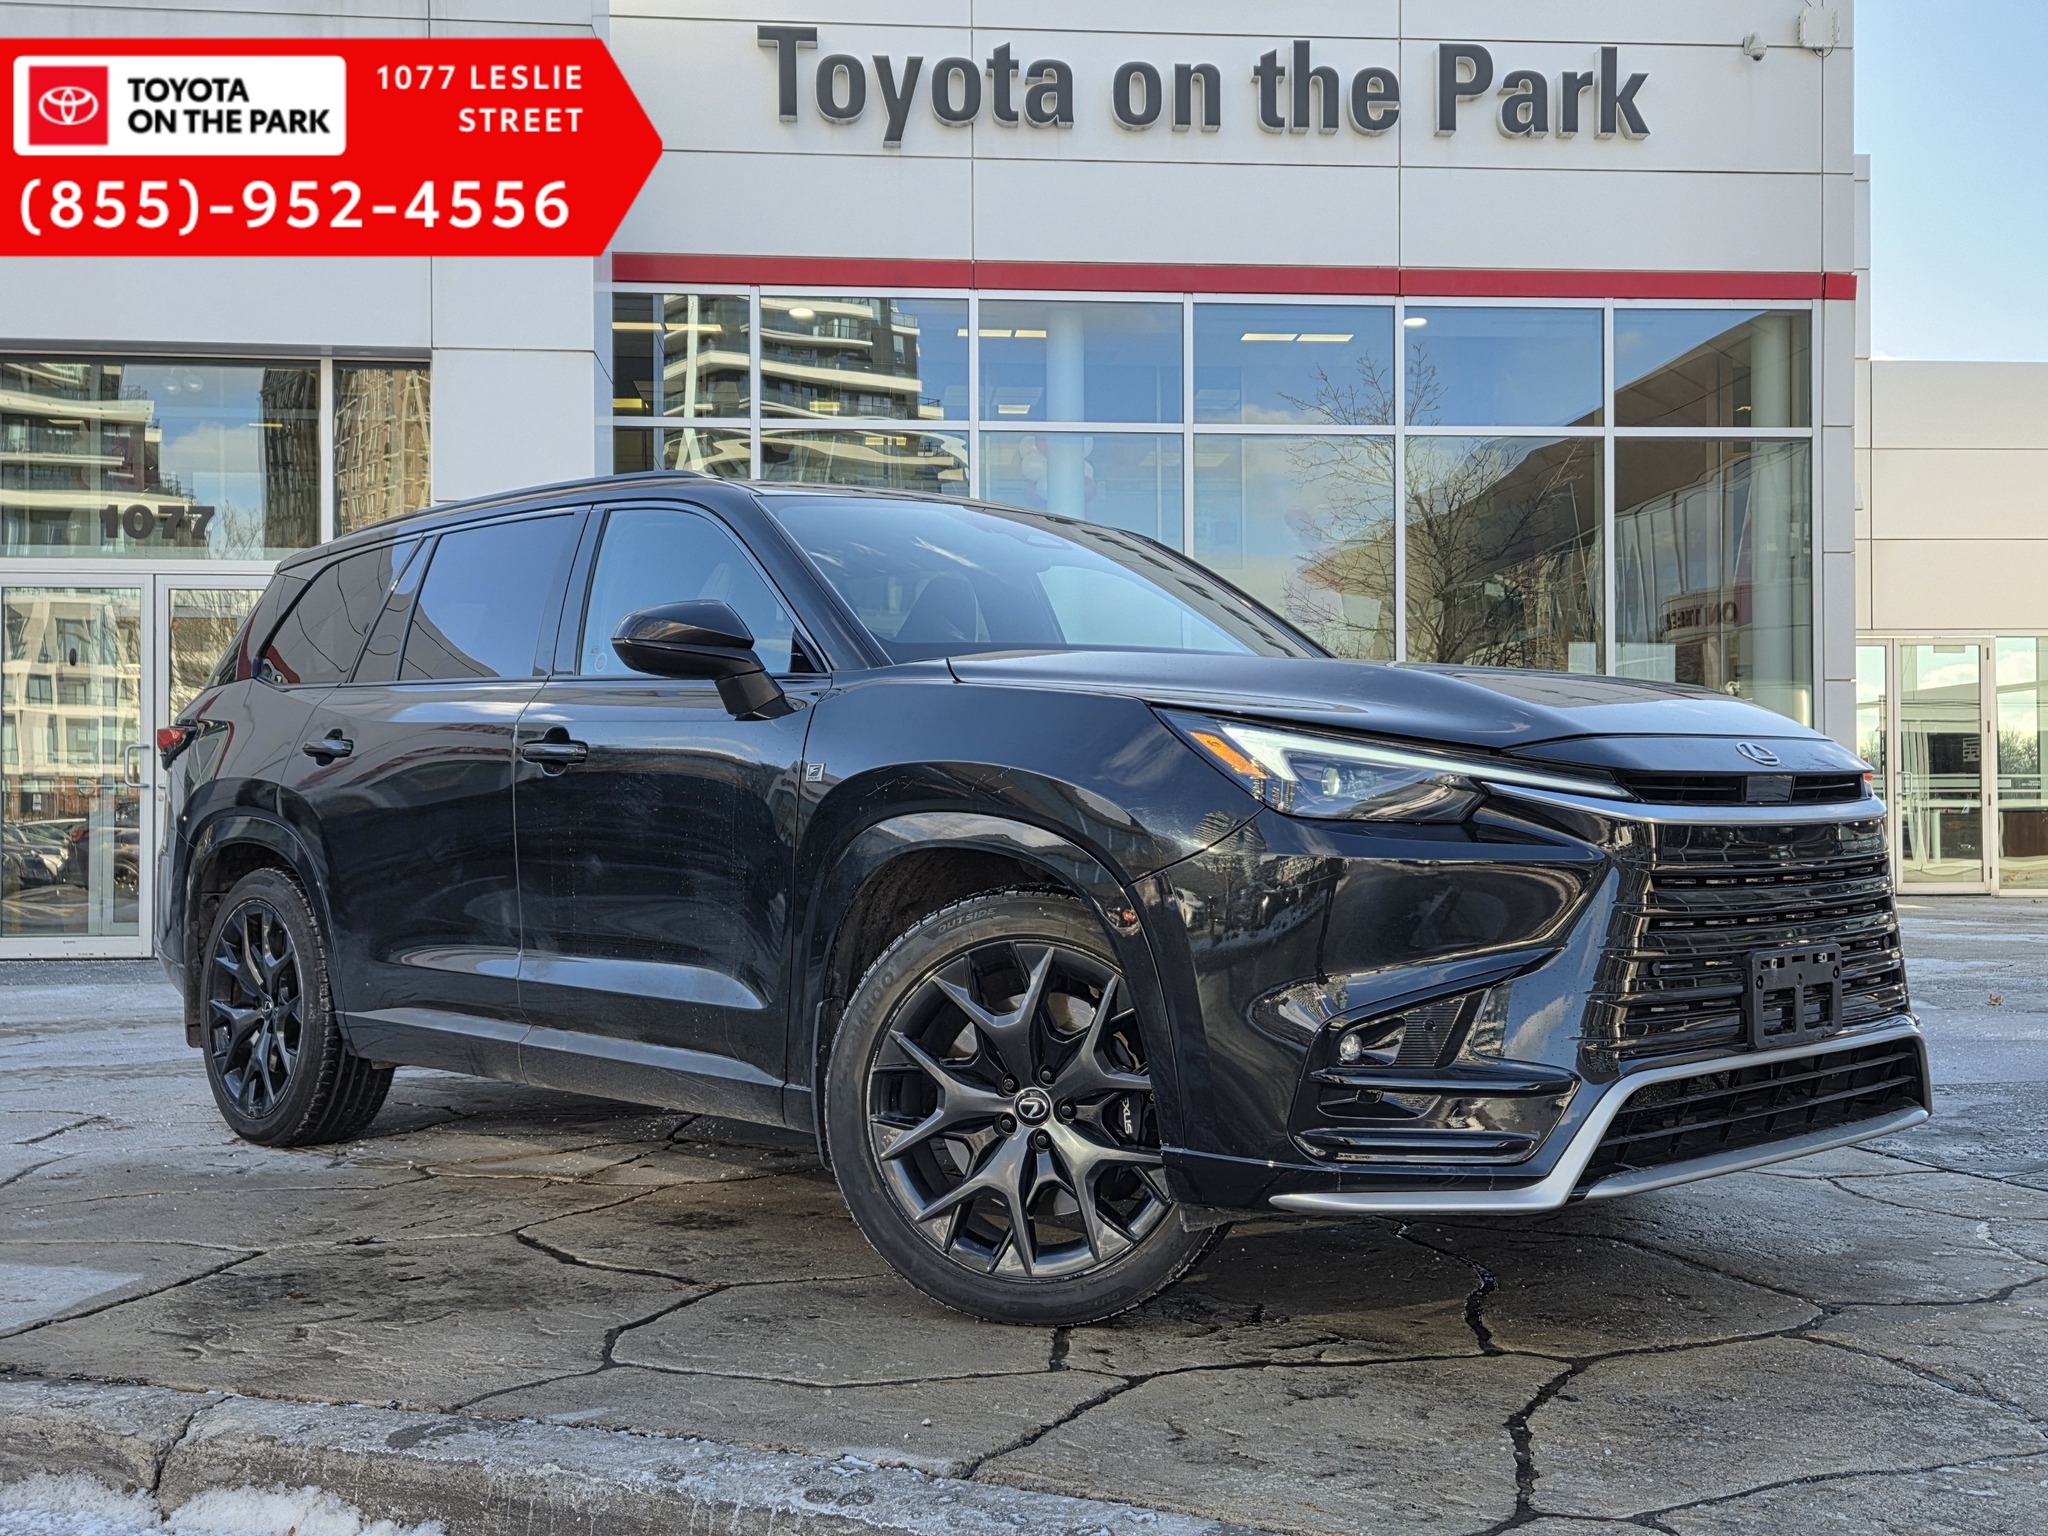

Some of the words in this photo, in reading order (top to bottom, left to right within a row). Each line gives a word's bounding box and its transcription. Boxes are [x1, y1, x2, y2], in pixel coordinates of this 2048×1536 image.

[757, 25, 1075, 147] Toyota
[1112, 60, 1221, 132] on
[1251, 40, 1400, 137] the
[1433, 43, 1651, 140] Park
[99, 504, 215, 539] 1077
[937, 907, 997, 933] OUTSIDE
